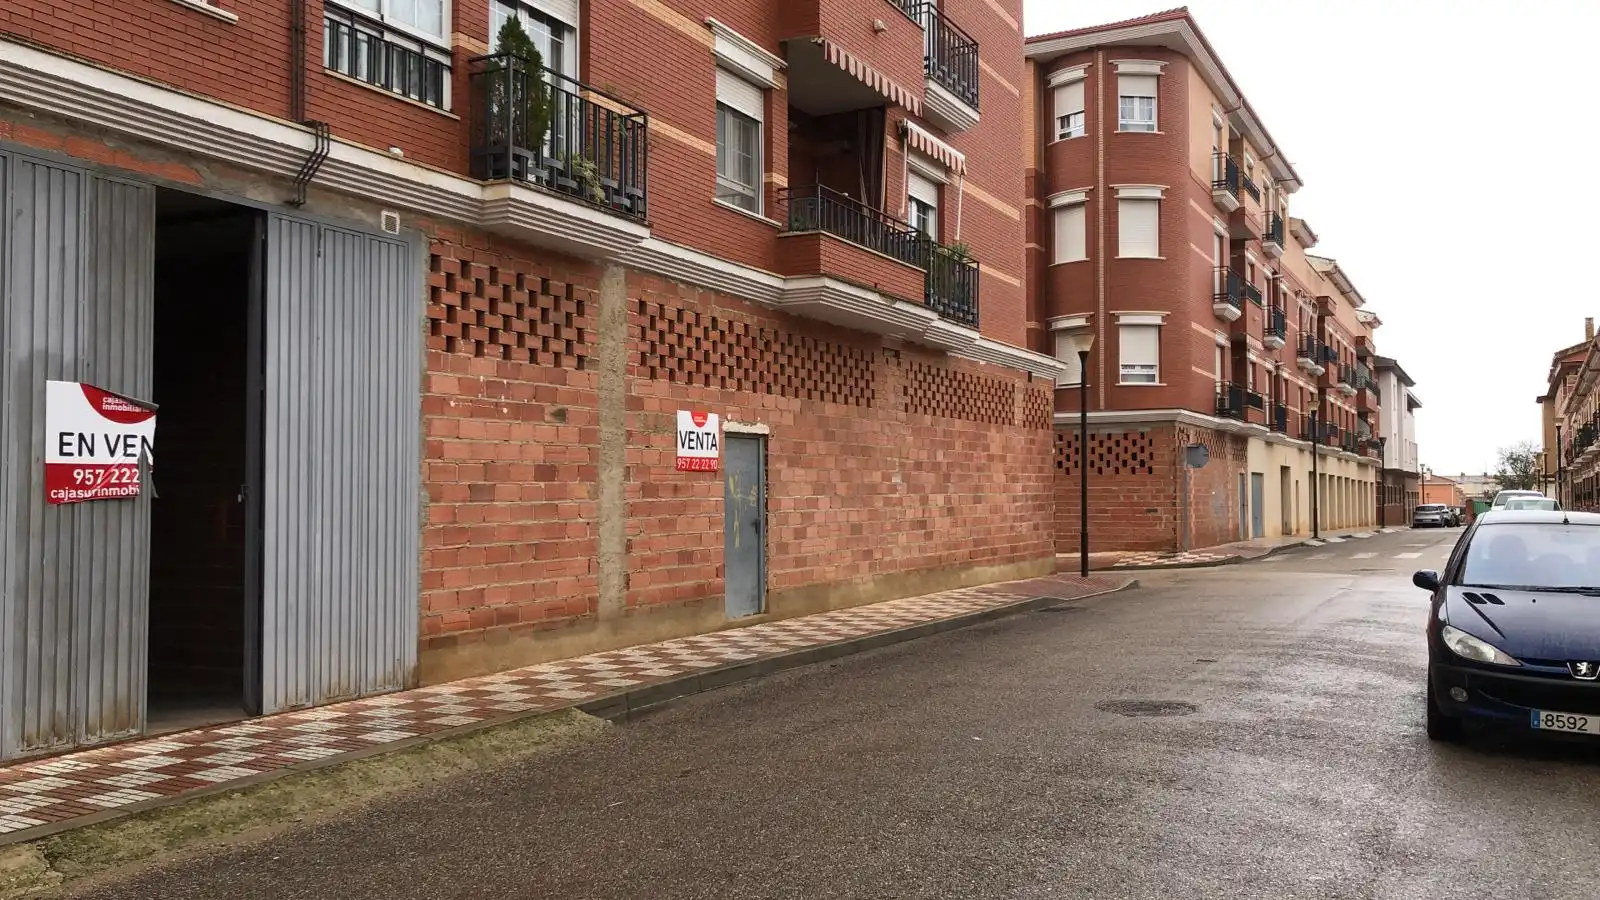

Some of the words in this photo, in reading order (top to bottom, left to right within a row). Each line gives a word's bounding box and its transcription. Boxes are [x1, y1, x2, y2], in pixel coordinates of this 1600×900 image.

[58, 432, 95, 457] EN
[104, 433, 154, 458] VEN
[679, 430, 718, 451] VENTA
[677, 458, 690, 469] 957
[691, 459, 700, 469] 22
[701, 459, 710, 470] 22
[710, 459, 718, 470] 90
[73, 468, 105, 485] 957
[1544, 713, 1589, 731] 8592
